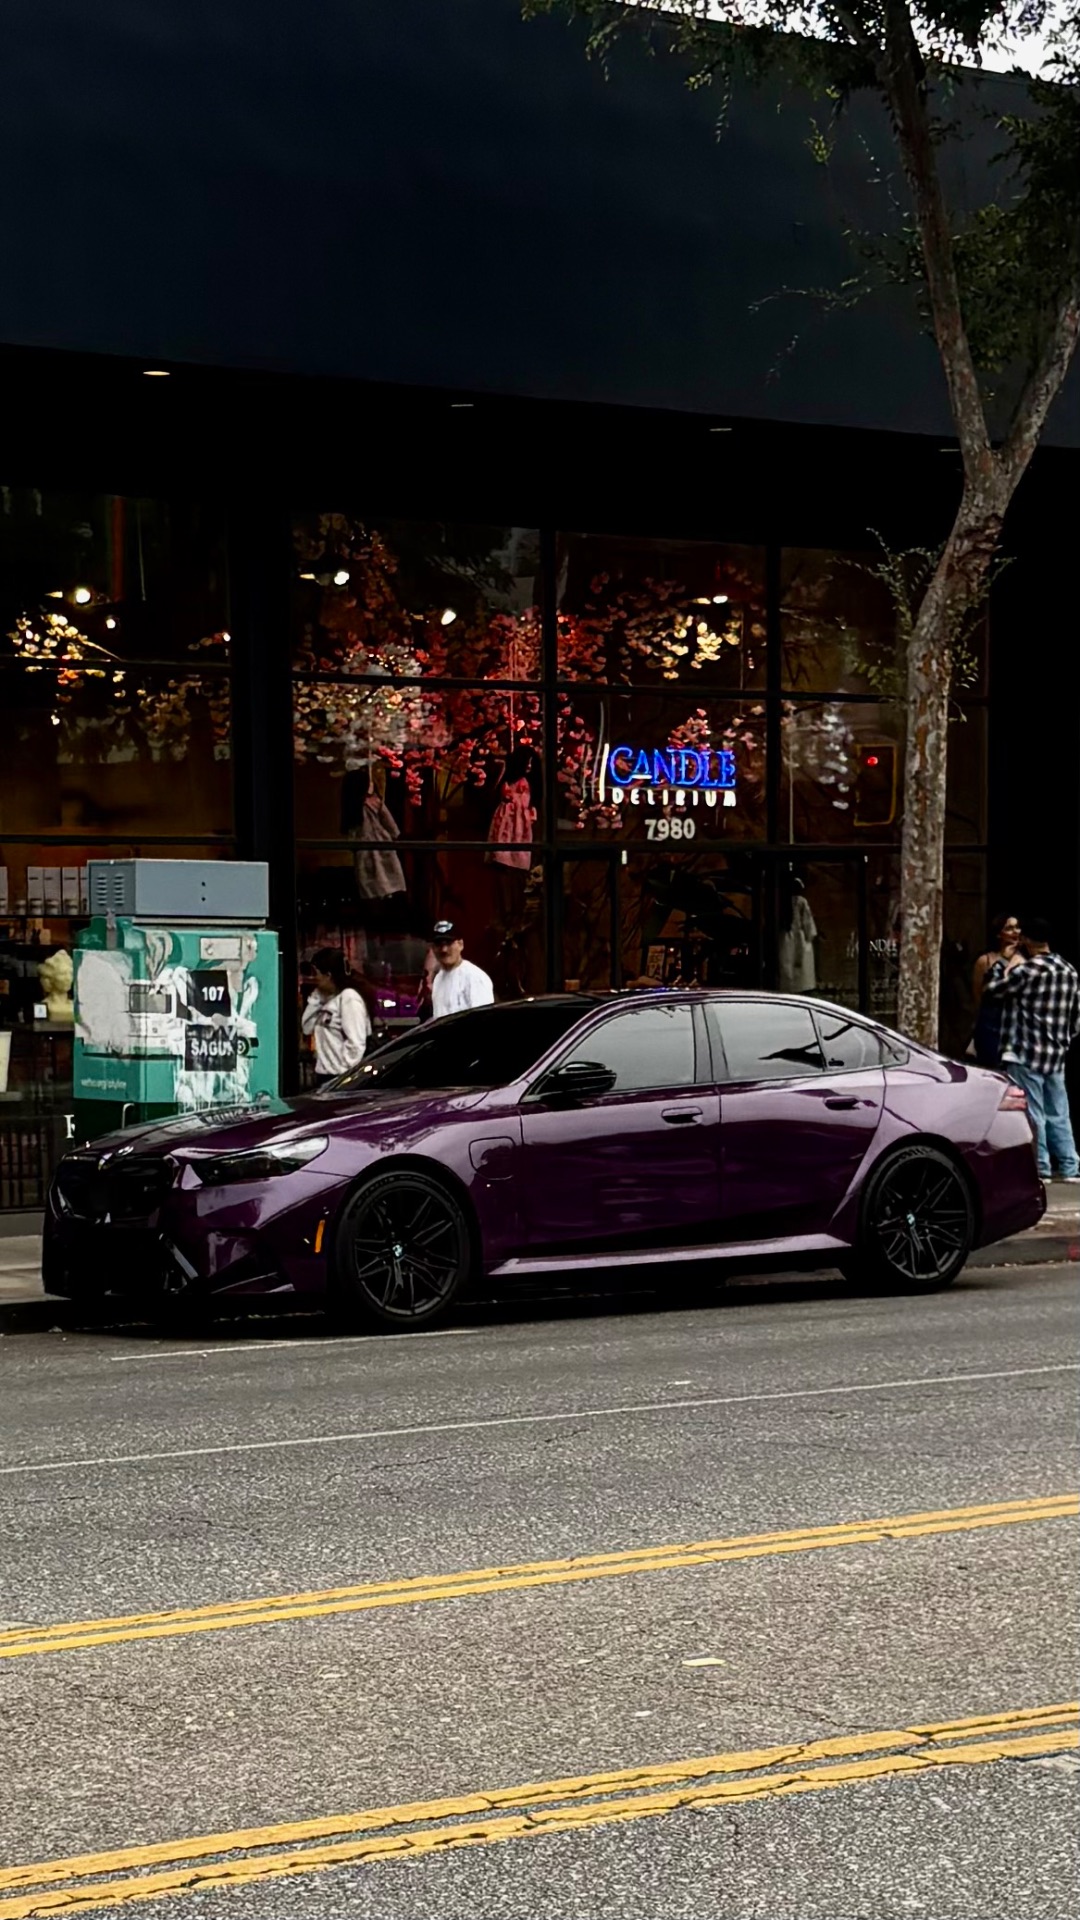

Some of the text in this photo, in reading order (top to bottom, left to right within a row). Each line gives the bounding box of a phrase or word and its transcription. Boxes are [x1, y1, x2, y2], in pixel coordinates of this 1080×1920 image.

[609, 745, 737, 787] CANDLE
[612, 788, 737, 807] DELIRIUM
[644, 818, 696, 841] 7980
[201, 985, 226, 1002] 107
